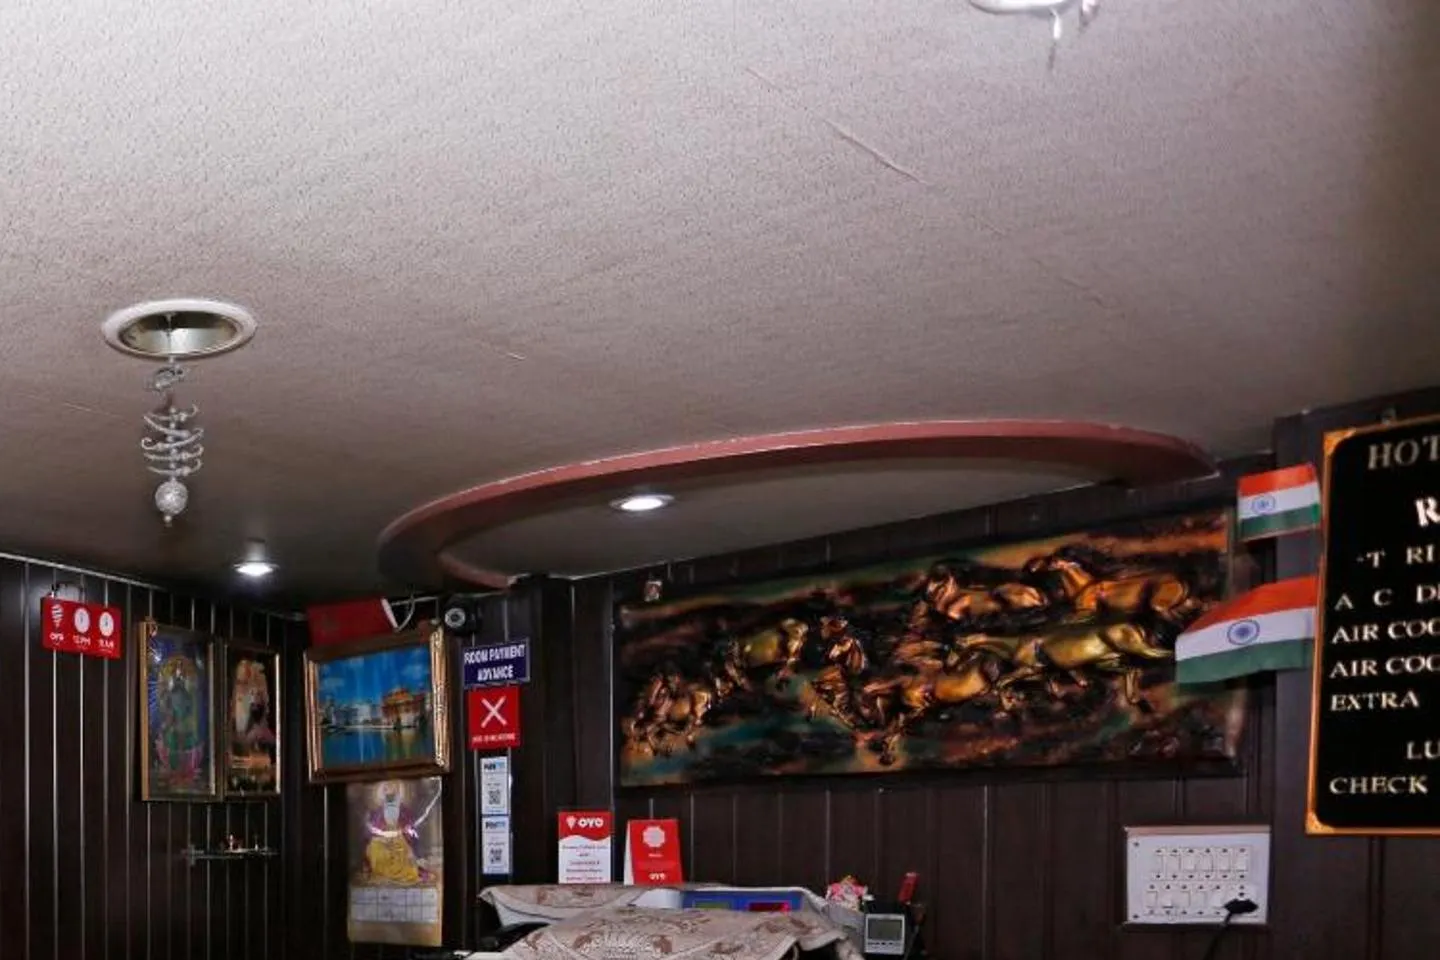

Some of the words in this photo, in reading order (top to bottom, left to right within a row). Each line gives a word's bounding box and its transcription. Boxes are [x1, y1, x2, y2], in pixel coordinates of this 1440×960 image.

[1368, 435, 1440, 470] HOT
[1334, 593, 1354, 611] A
[1373, 588, 1393, 606] C
[1415, 583, 1440, 603] D
[1331, 623, 1380, 644] AIR
[1329, 659, 1378, 679] AIR
[1330, 689, 1420, 711] EXTRA
[1329, 775, 1429, 795] CHECK
[578, 817, 604, 828] OYO
